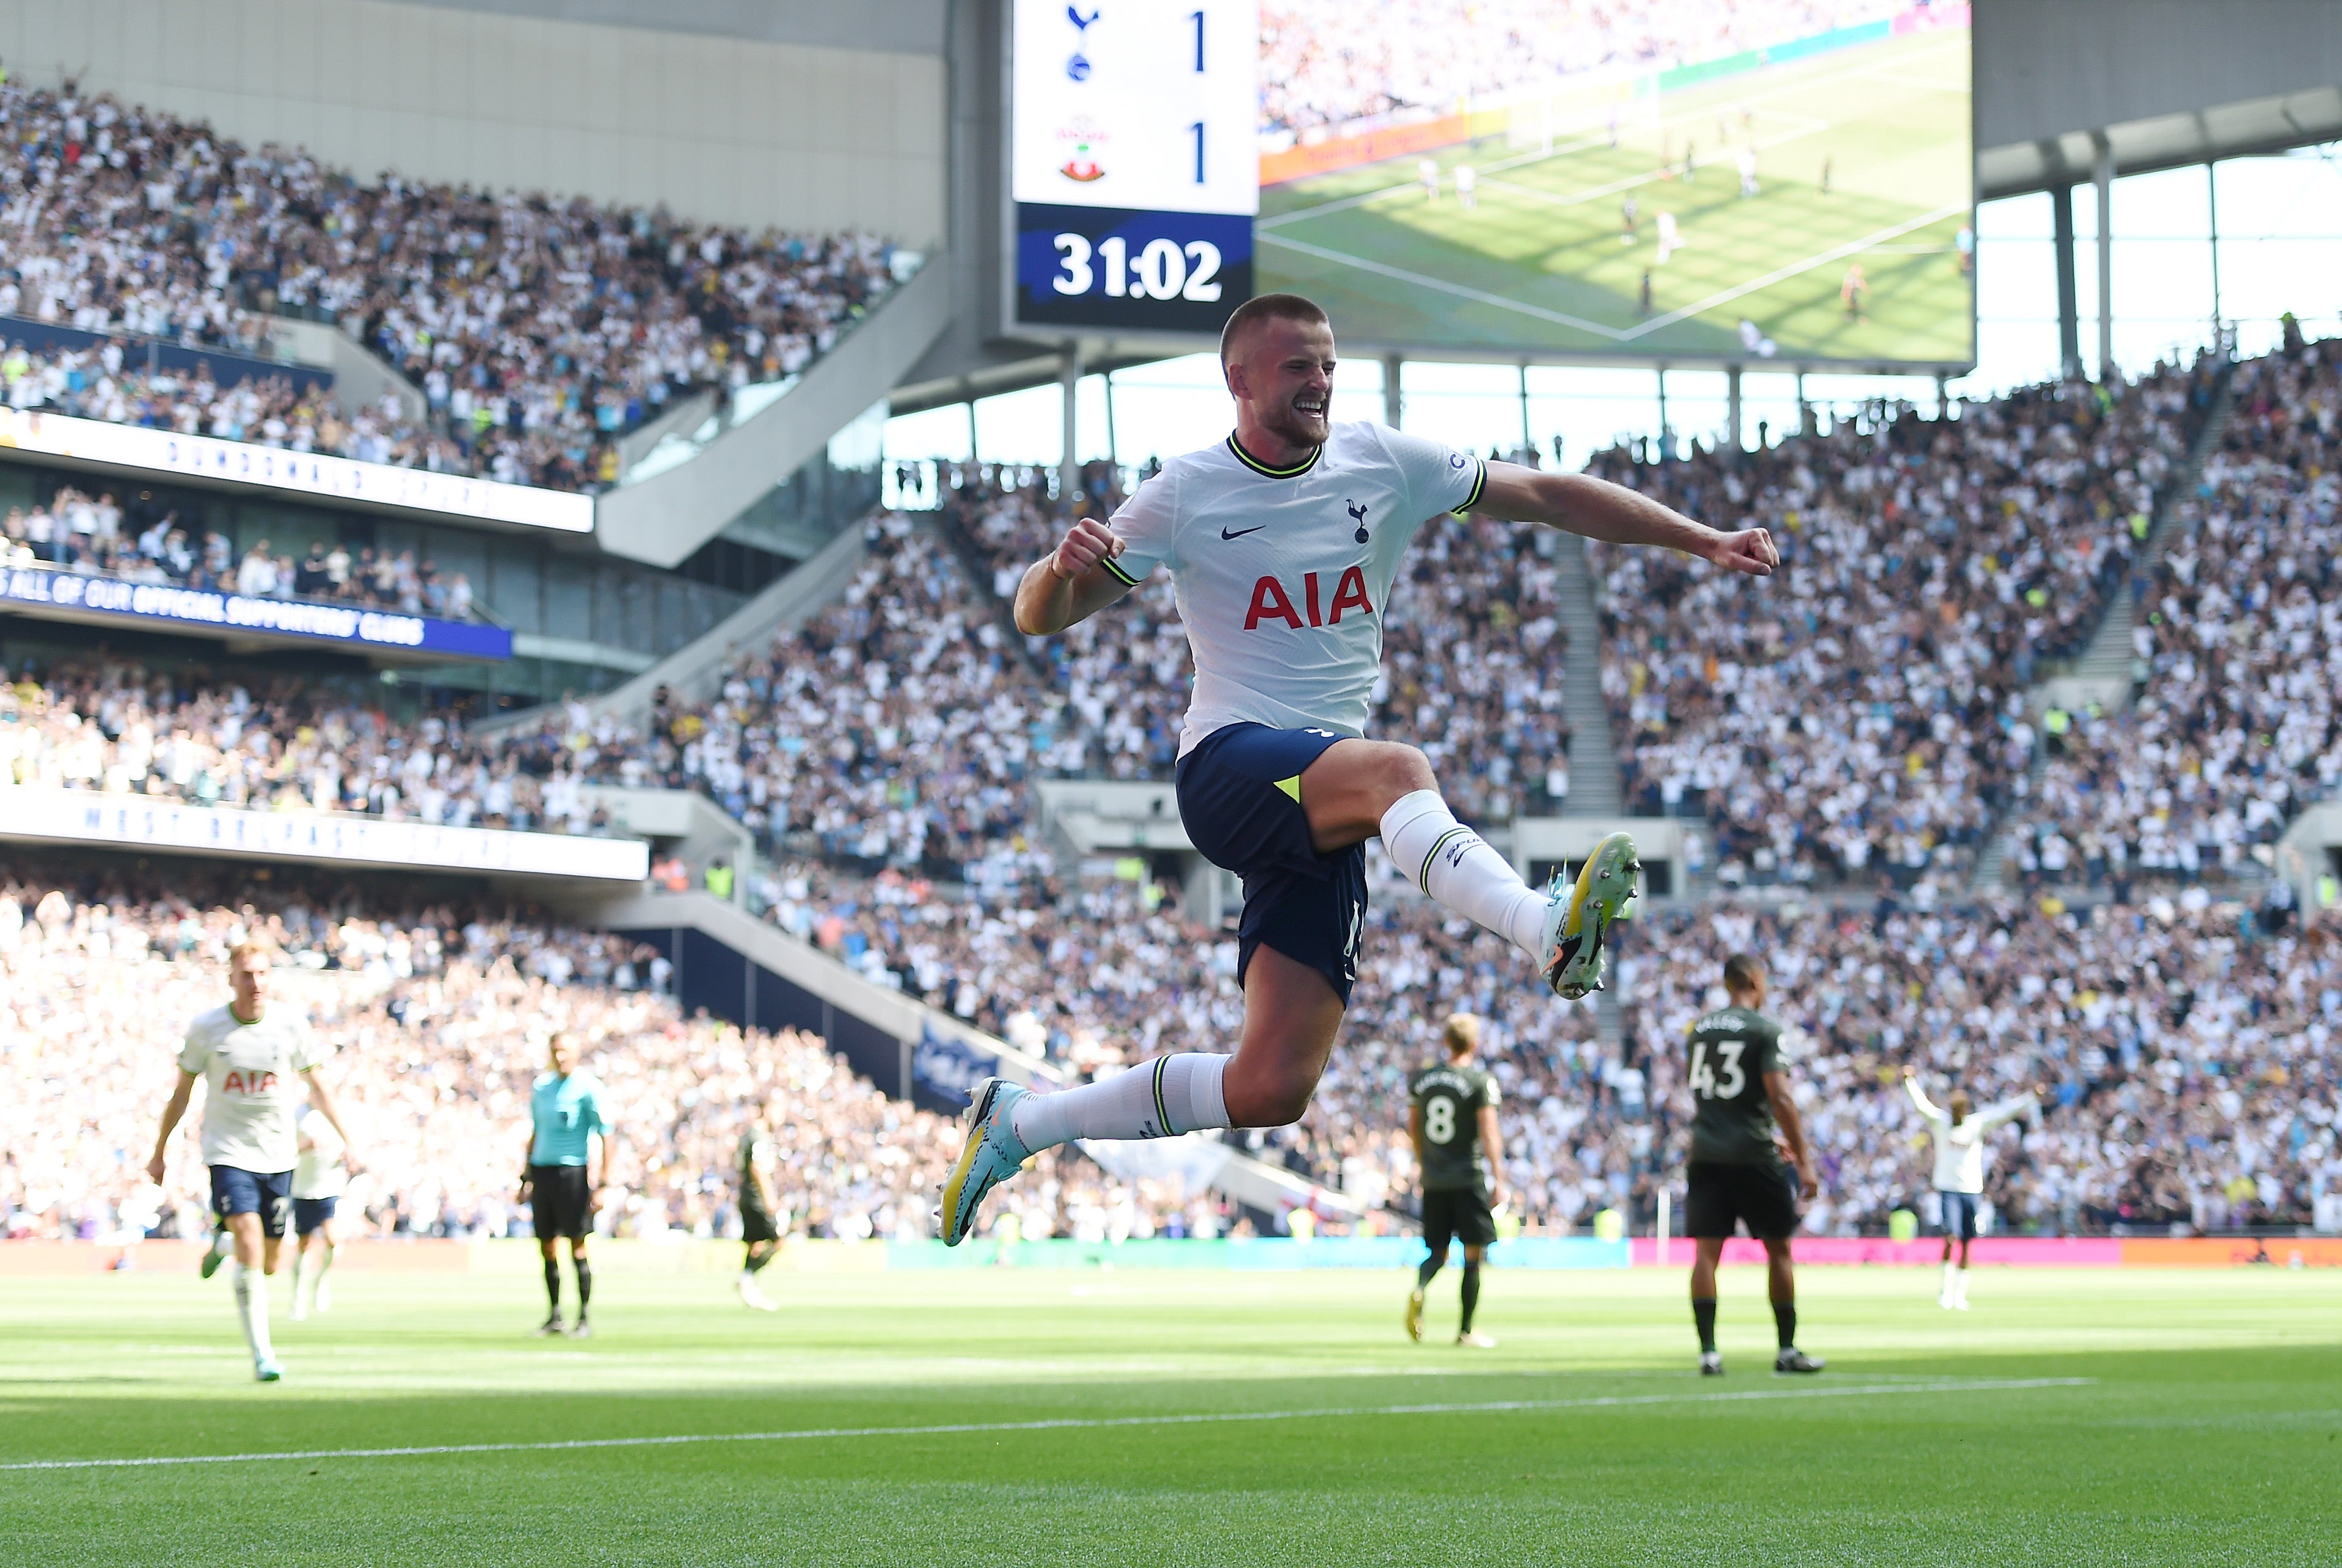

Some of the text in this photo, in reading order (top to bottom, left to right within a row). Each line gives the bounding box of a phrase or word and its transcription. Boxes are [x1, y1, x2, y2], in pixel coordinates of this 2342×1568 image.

[1188, 11, 1204, 71] 1
[1188, 122, 1204, 183] 1
[1052, 232, 1222, 302] 31:02
[53, 575, 86, 604] OF
[86, 579, 133, 611] OUR
[133, 585, 225, 623] OFFICIAL
[359, 612, 425, 646] CLUBS
[1244, 566, 1373, 630] AIA
[223, 1070, 278, 1095] AIA
[1688, 1040, 1747, 1100] 43
[1425, 1095, 1456, 1145] 8
